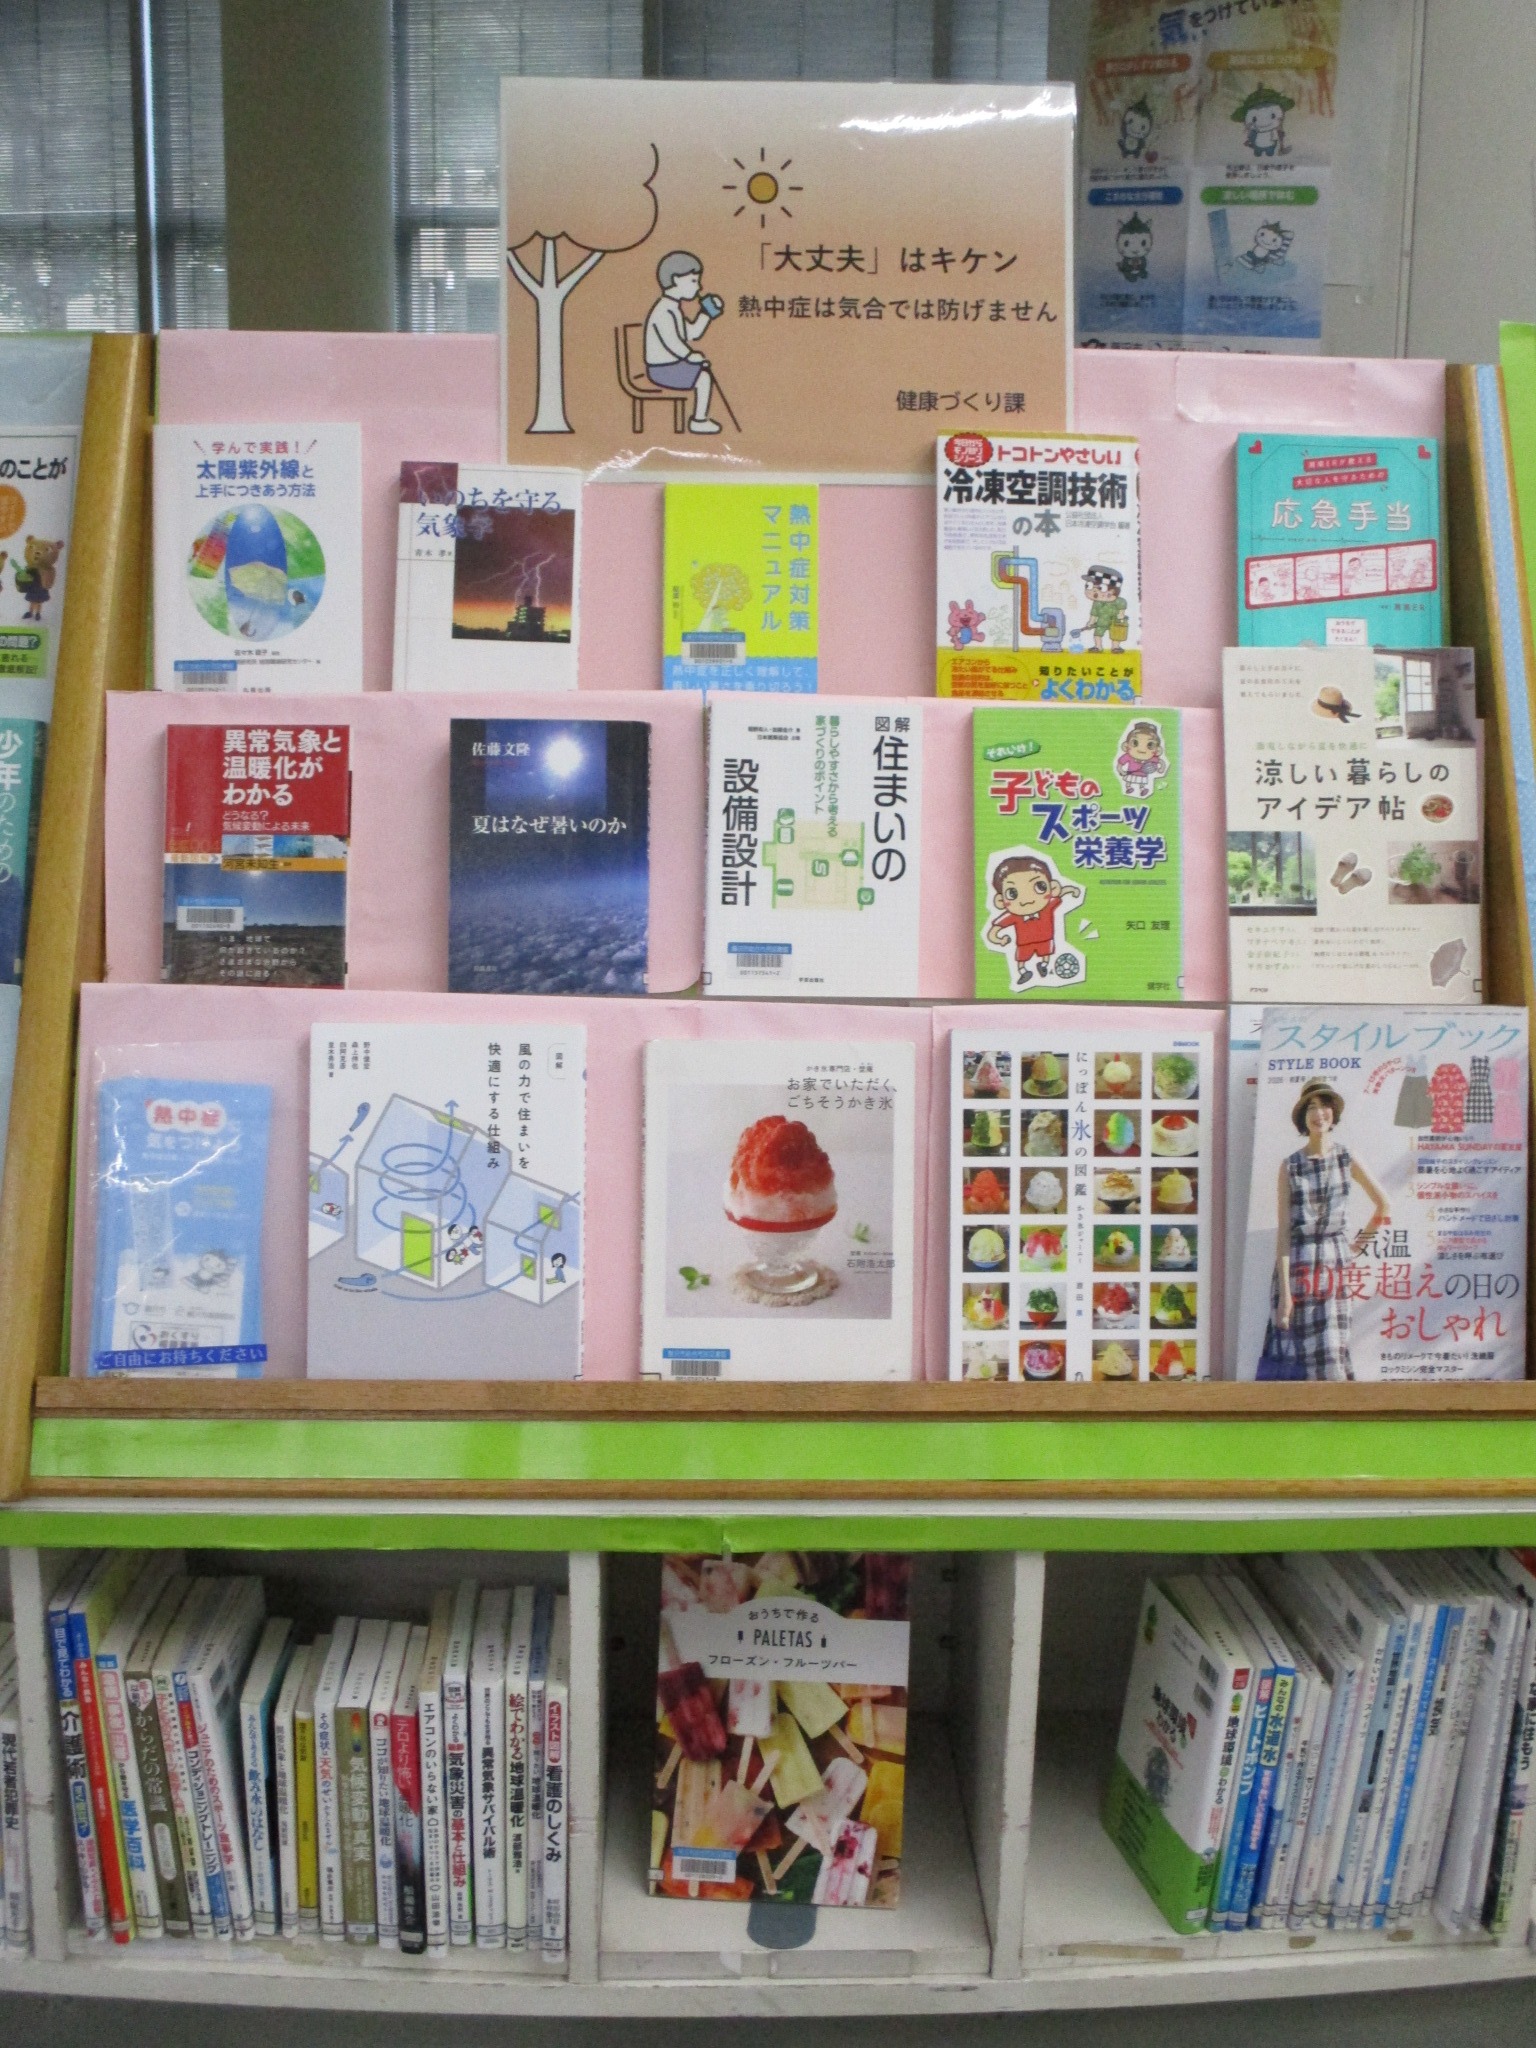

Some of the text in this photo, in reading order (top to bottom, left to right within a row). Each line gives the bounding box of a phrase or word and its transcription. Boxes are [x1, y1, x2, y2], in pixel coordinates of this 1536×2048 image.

[760, 242, 1018, 275] 「大丈夫」はキケン
[738, 295, 1058, 323] 熱中症は気合では防げません
[896, 389, 1026, 414] 健康づくり課
[0, 458, 67, 479] のことが
[997, 445, 1122, 465] トコトンやさしい
[197, 460, 314, 479] 太陽紫外線と
[195, 484, 316, 498] 上手につきあう方法
[943, 468, 1128, 508] 冷凍空調技術
[416, 511, 494, 541] 気象学
[1012, 508, 1061, 537] の本
[1271, 498, 1412, 532] 応急手当
[761, 505, 781, 632] マニュアル
[789, 503, 810, 632] 熱中症対策
[1039, 666, 1134, 677] 知りたいことが
[1040, 678, 1135, 701] よくわかる
[874, 716, 910, 733] 図解
[223, 729, 342, 753] 異常気象と
[472, 742, 531, 757] 佐藤文隆
[222, 756, 323, 780] 温暖化が
[814, 715, 827, 815] 家づくりのポイント
[827, 715, 840, 838] 暮らしやすさから考える
[1255, 757, 1450, 786] 涼しい暮らしの
[222, 783, 294, 806] わかる
[989, 769, 1101, 815] 子どもの
[222, 811, 269, 821] どうなる?
[872, 735, 909, 883] 住まいの
[1257, 794, 1406, 821] アイデア帖
[222, 821, 311, 831] 気候変動による未来
[472, 814, 627, 835] 夏はなぜ暑いのか
[721, 758, 759, 906] 設備設計
[1031, 803, 1149, 844] スポーツ
[1073, 836, 1166, 869] 栄養学
[1271, 1020, 1521, 1052] スタイルブック
[1268, 1057, 1362, 1071] STYLE BOOK
[787, 1078, 898, 1092] お家でいただく、
[153, 1104, 220, 1127] 熱中症
[487, 1042, 501, 1169] 快適にする仕組み
[518, 1043, 532, 1169] 風の力で住まいを
[787, 1095, 894, 1110] ごちそうかき氷
[1072, 1051, 1092, 1197] にっぽん氷の図鑑
[1354, 1228, 1411, 1260] 気温
[1295, 1262, 1520, 1301] 30度超えの日の
[1380, 1305, 1508, 1342] おしゃれ
[100, 1346, 264, 1368] ご自由にお持ちください
[1380, 1365, 1464, 1374] ロックミシン完全マスター
[748, 1607, 820, 1624] おうちで作る
[753, 1629, 813, 1649] PALETAS
[708, 1655, 858, 1669] フローズン・フルーツバー
[424, 1703, 438, 1816] エアコンのいらない家
[509, 1693, 525, 1828] 絵でわかる地球温暖化
[482, 1746, 496, 1859] 異常気象サバイバル術
[546, 1764, 563, 1863] 看護のしくみ
